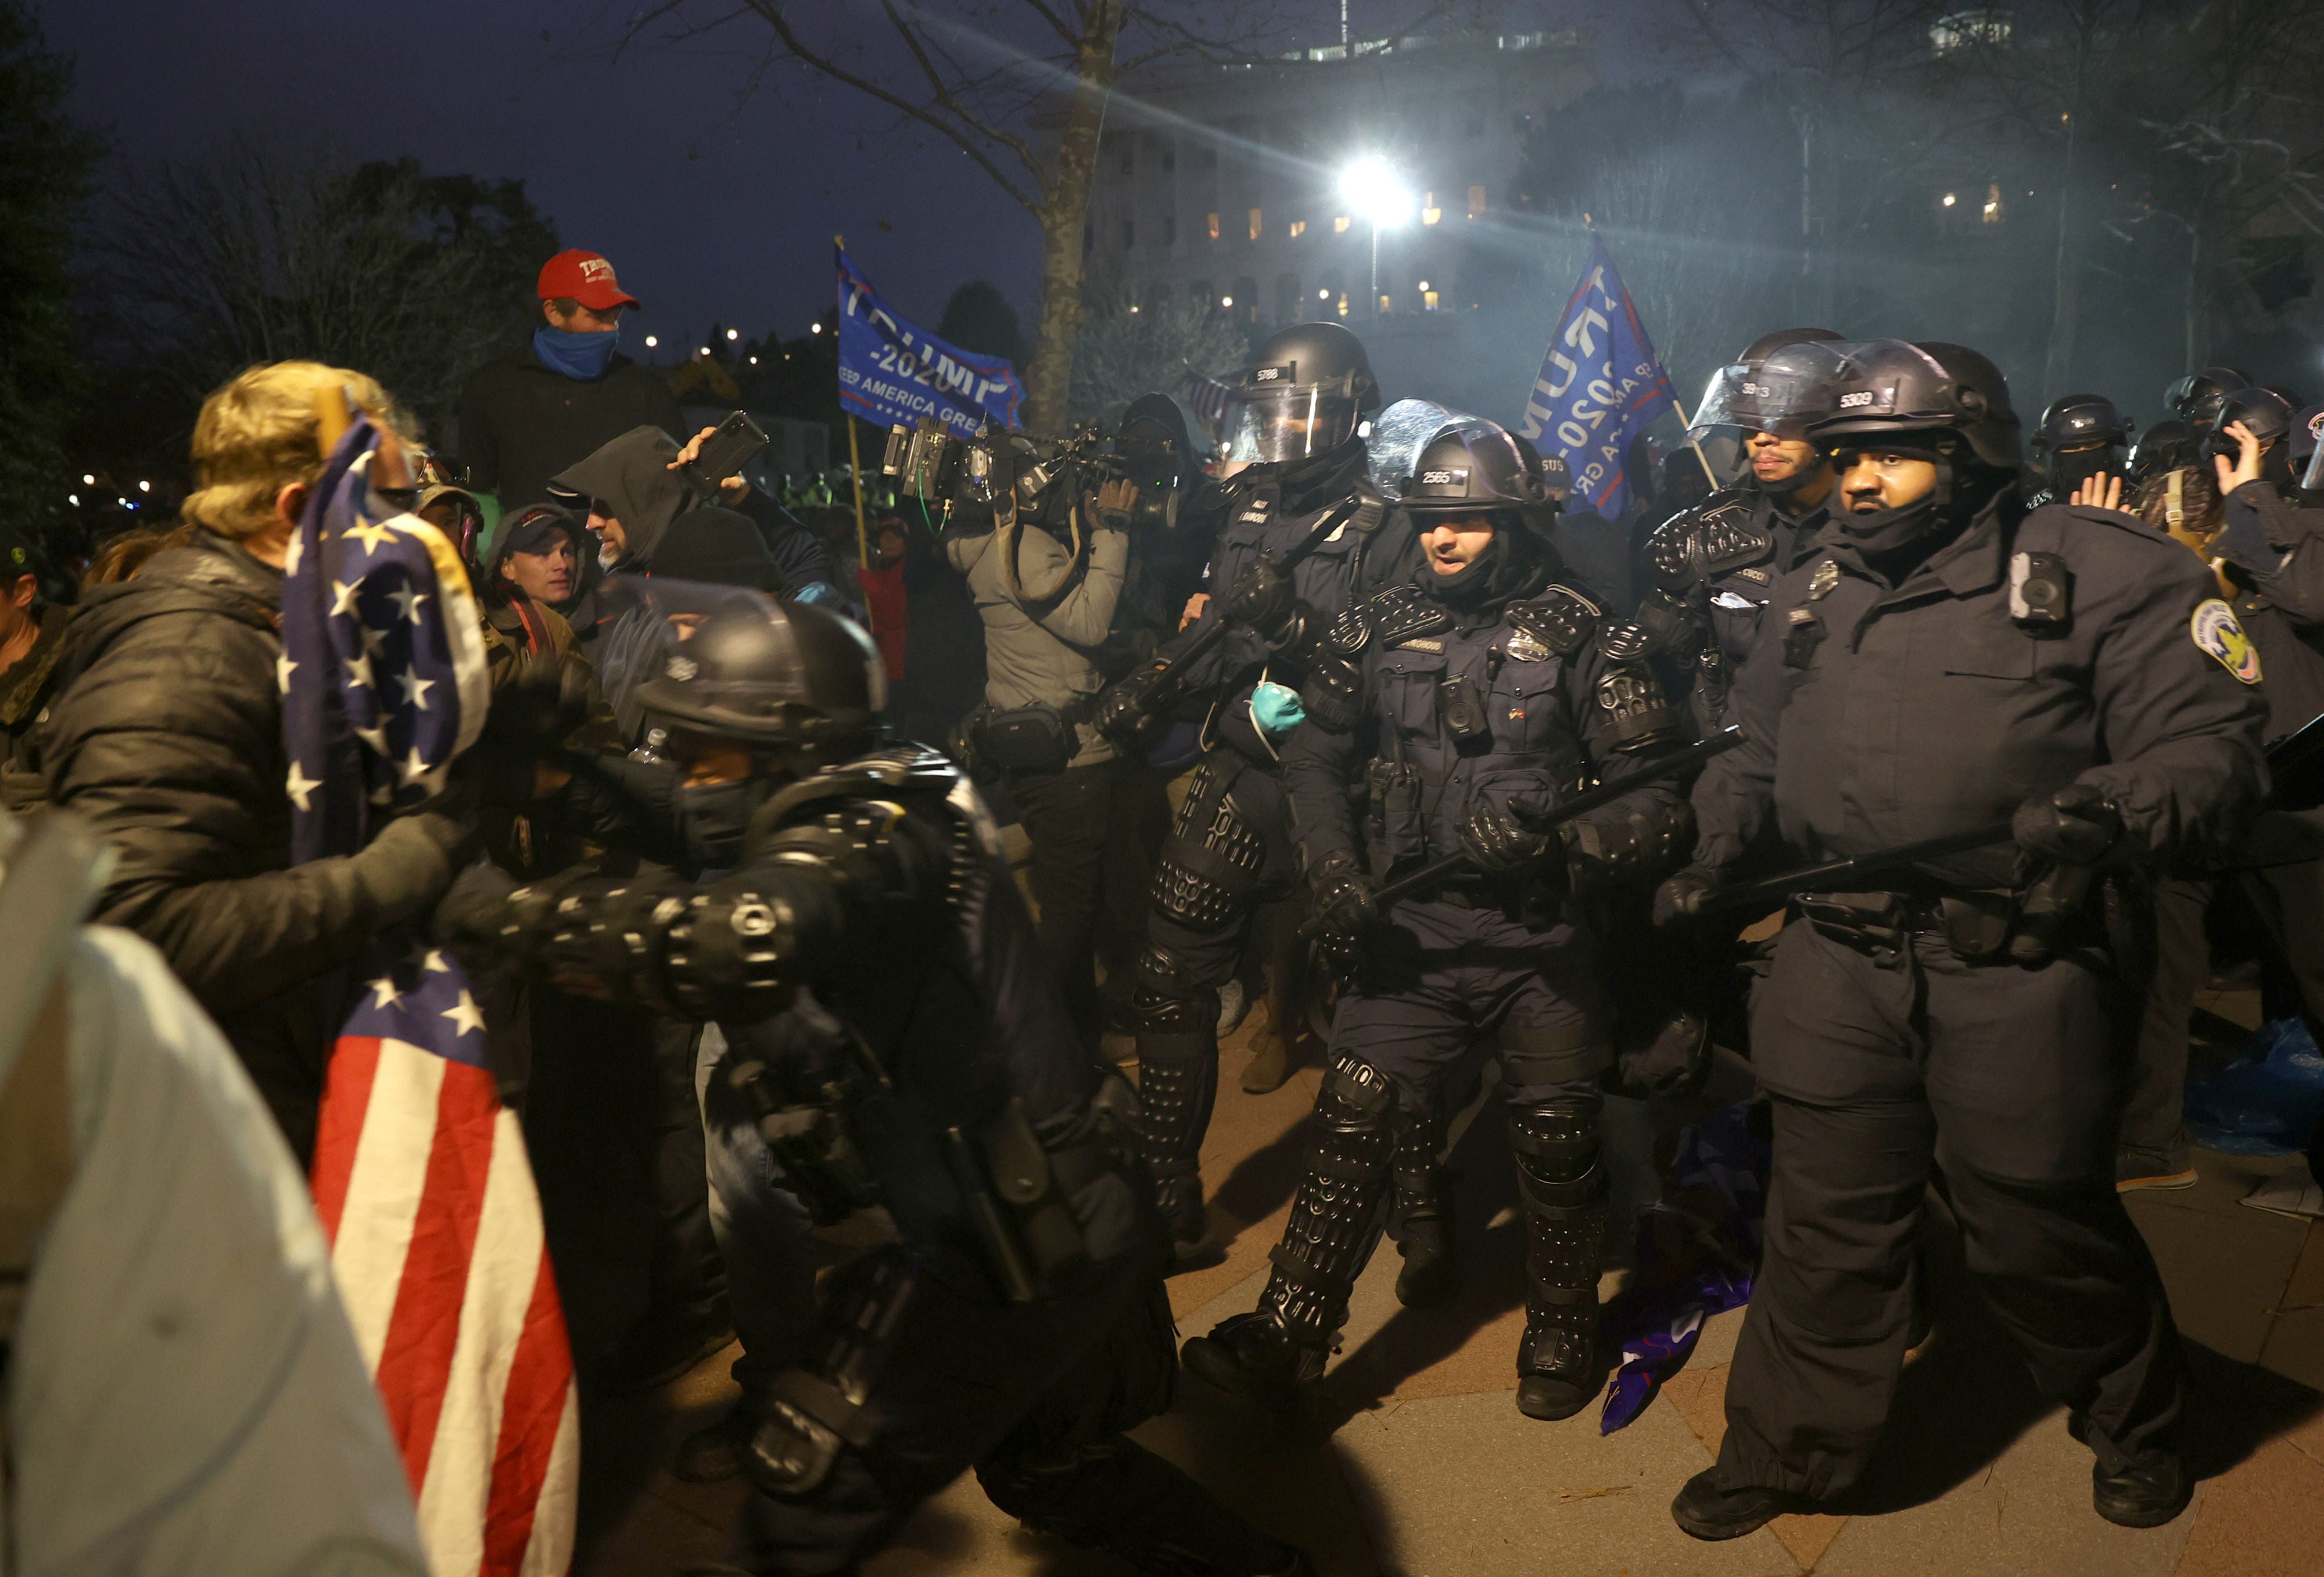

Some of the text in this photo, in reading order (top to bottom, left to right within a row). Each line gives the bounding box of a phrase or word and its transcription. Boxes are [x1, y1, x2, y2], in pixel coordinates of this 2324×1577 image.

[861, 377, 935, 416] AMERICA
[1742, 383, 1770, 397] 393
[1422, 471, 1450, 483] 2565
